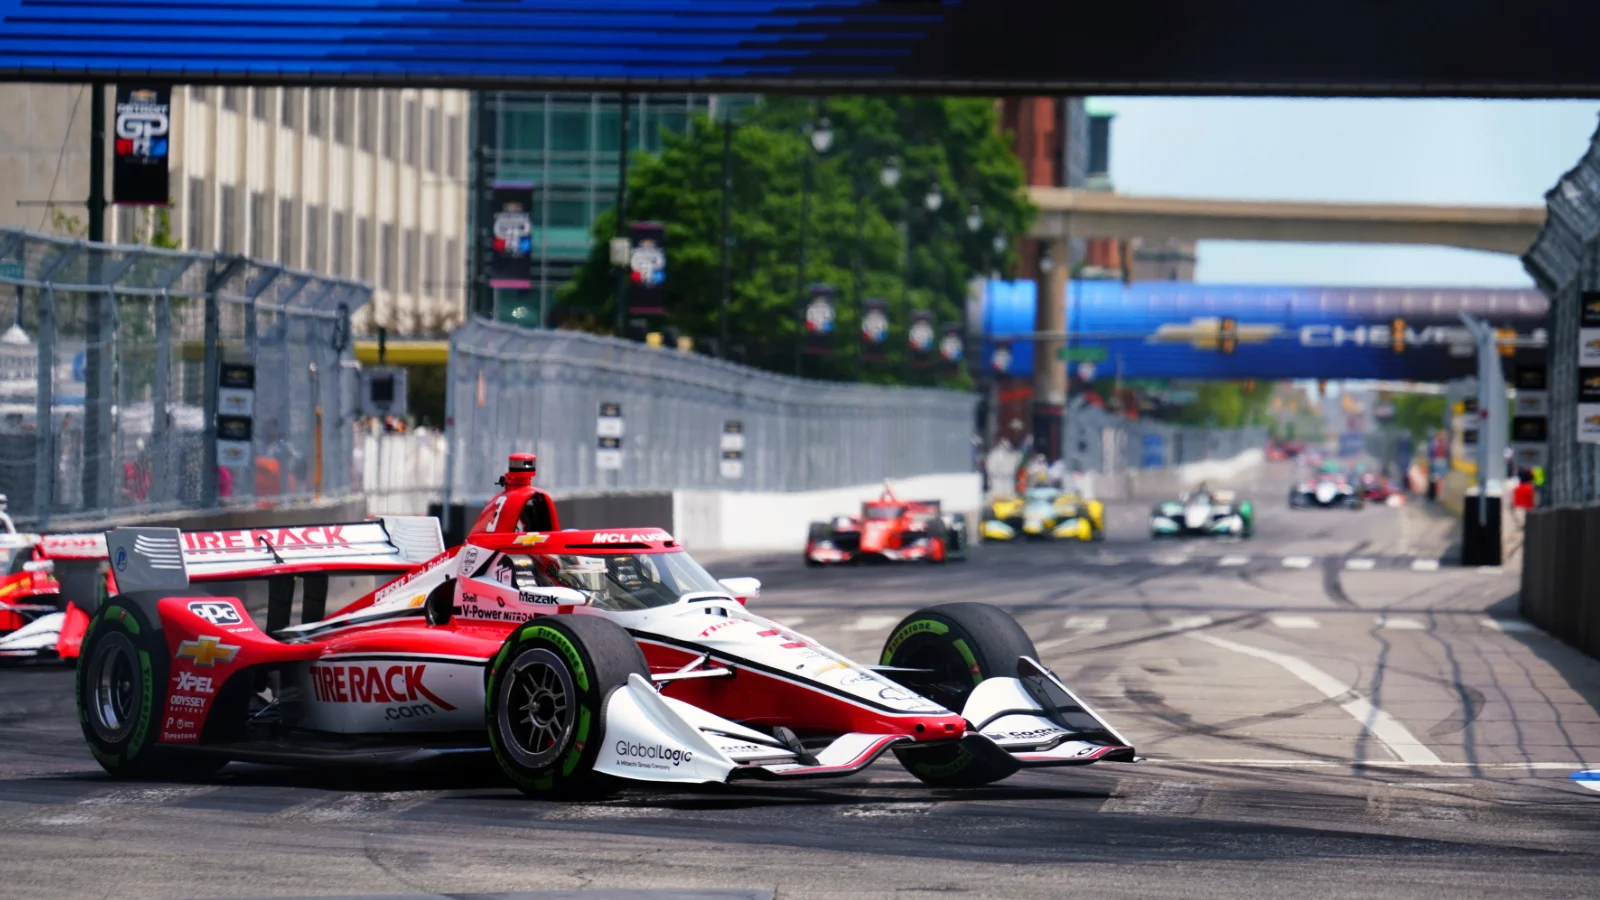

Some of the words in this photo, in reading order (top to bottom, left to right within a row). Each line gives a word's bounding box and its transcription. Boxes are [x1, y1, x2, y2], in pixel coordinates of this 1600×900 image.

[486, 496, 507, 533] 3
[247, 525, 364, 552] RACK
[374, 577, 406, 603] PENSKE
[462, 593, 478, 602] Shell
[519, 592, 559, 605] Mazak
[192, 604, 238, 623] PPG
[463, 605, 502, 619] V-Power
[887, 621, 931, 654] Firestone
[537, 627, 580, 669] Firestone
[177, 671, 214, 693] XPEL
[309, 665, 348, 702] TIRE
[348, 664, 458, 711] RACK
[170, 695, 207, 707] ODYSSEY
[170, 706, 204, 714] BATTERY
[384, 703, 437, 721] .com
[164, 732, 197, 740] Firestone
[615, 740, 693, 766] GlobalLogic
[651, 763, 671, 771] Company
